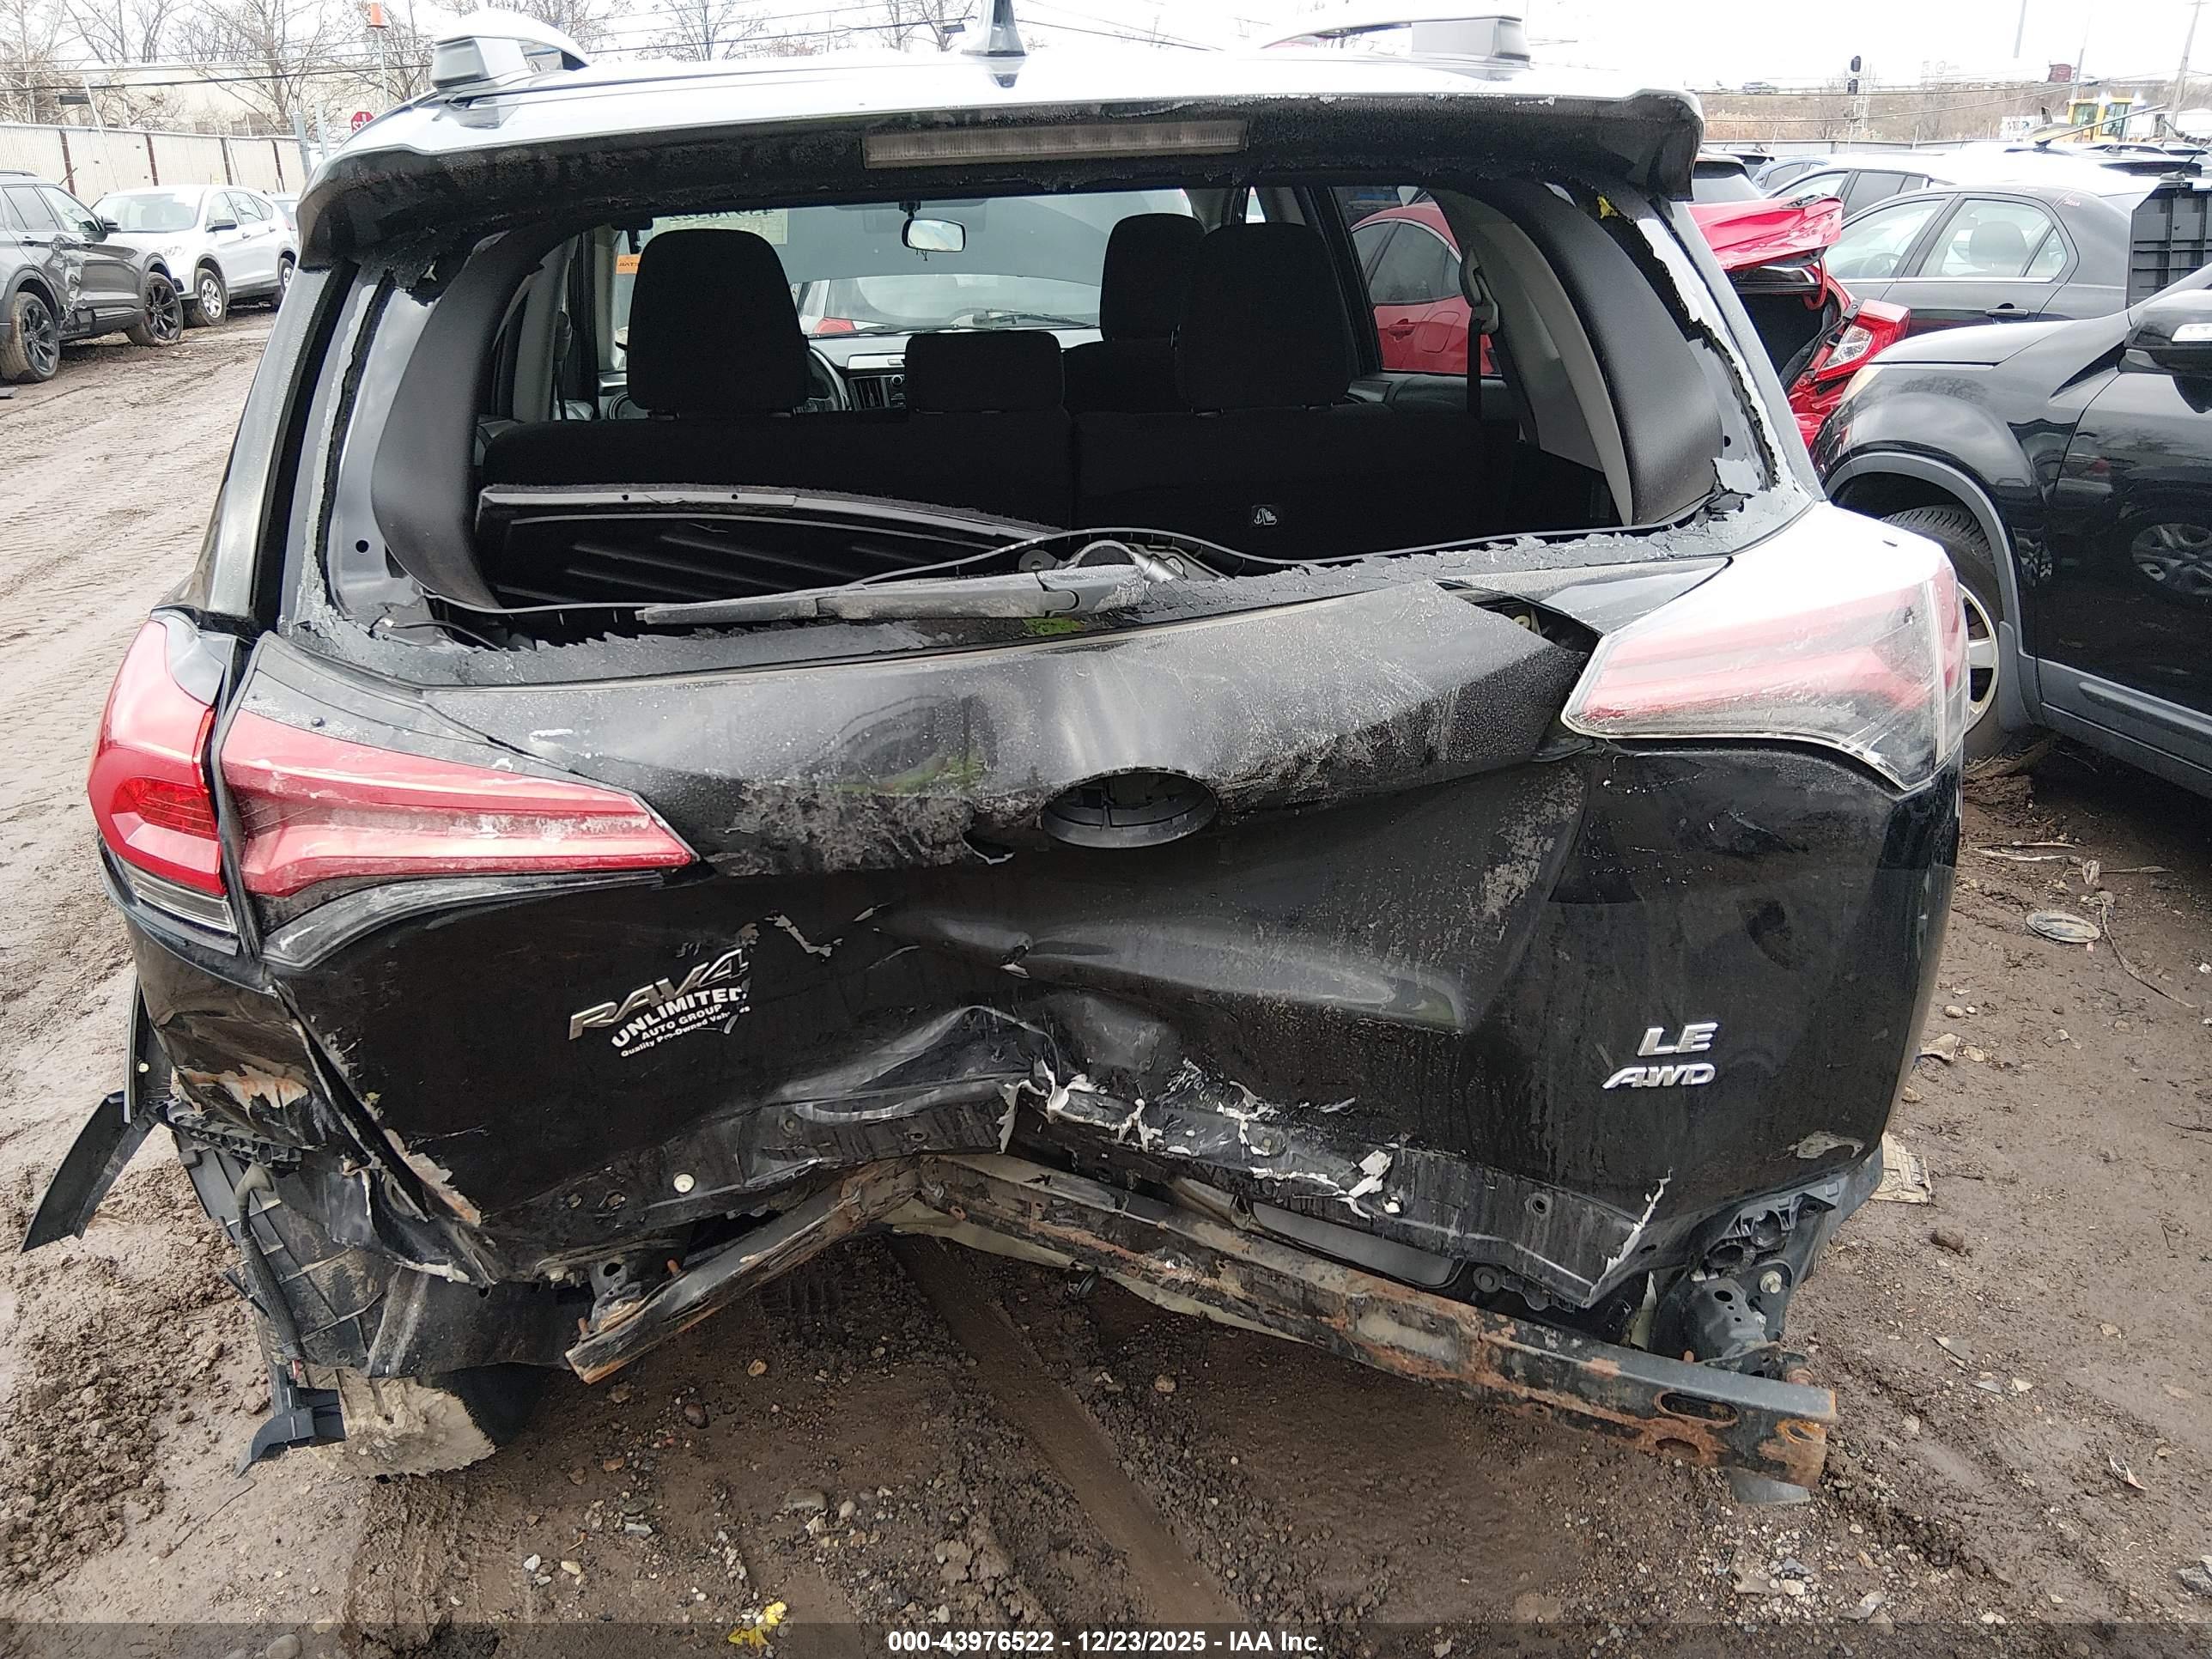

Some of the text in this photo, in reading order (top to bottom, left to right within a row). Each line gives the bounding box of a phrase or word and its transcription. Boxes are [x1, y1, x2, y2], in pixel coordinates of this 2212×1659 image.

[568, 948, 750, 1041] RAV4
[611, 987, 748, 1048] UNLIMITED
[641, 1004, 723, 1041] AUTO GROUP
[620, 1040, 656, 1058] Quality
[1637, 1022, 1719, 1057] LE
[1601, 1062, 1717, 1091] AWD
